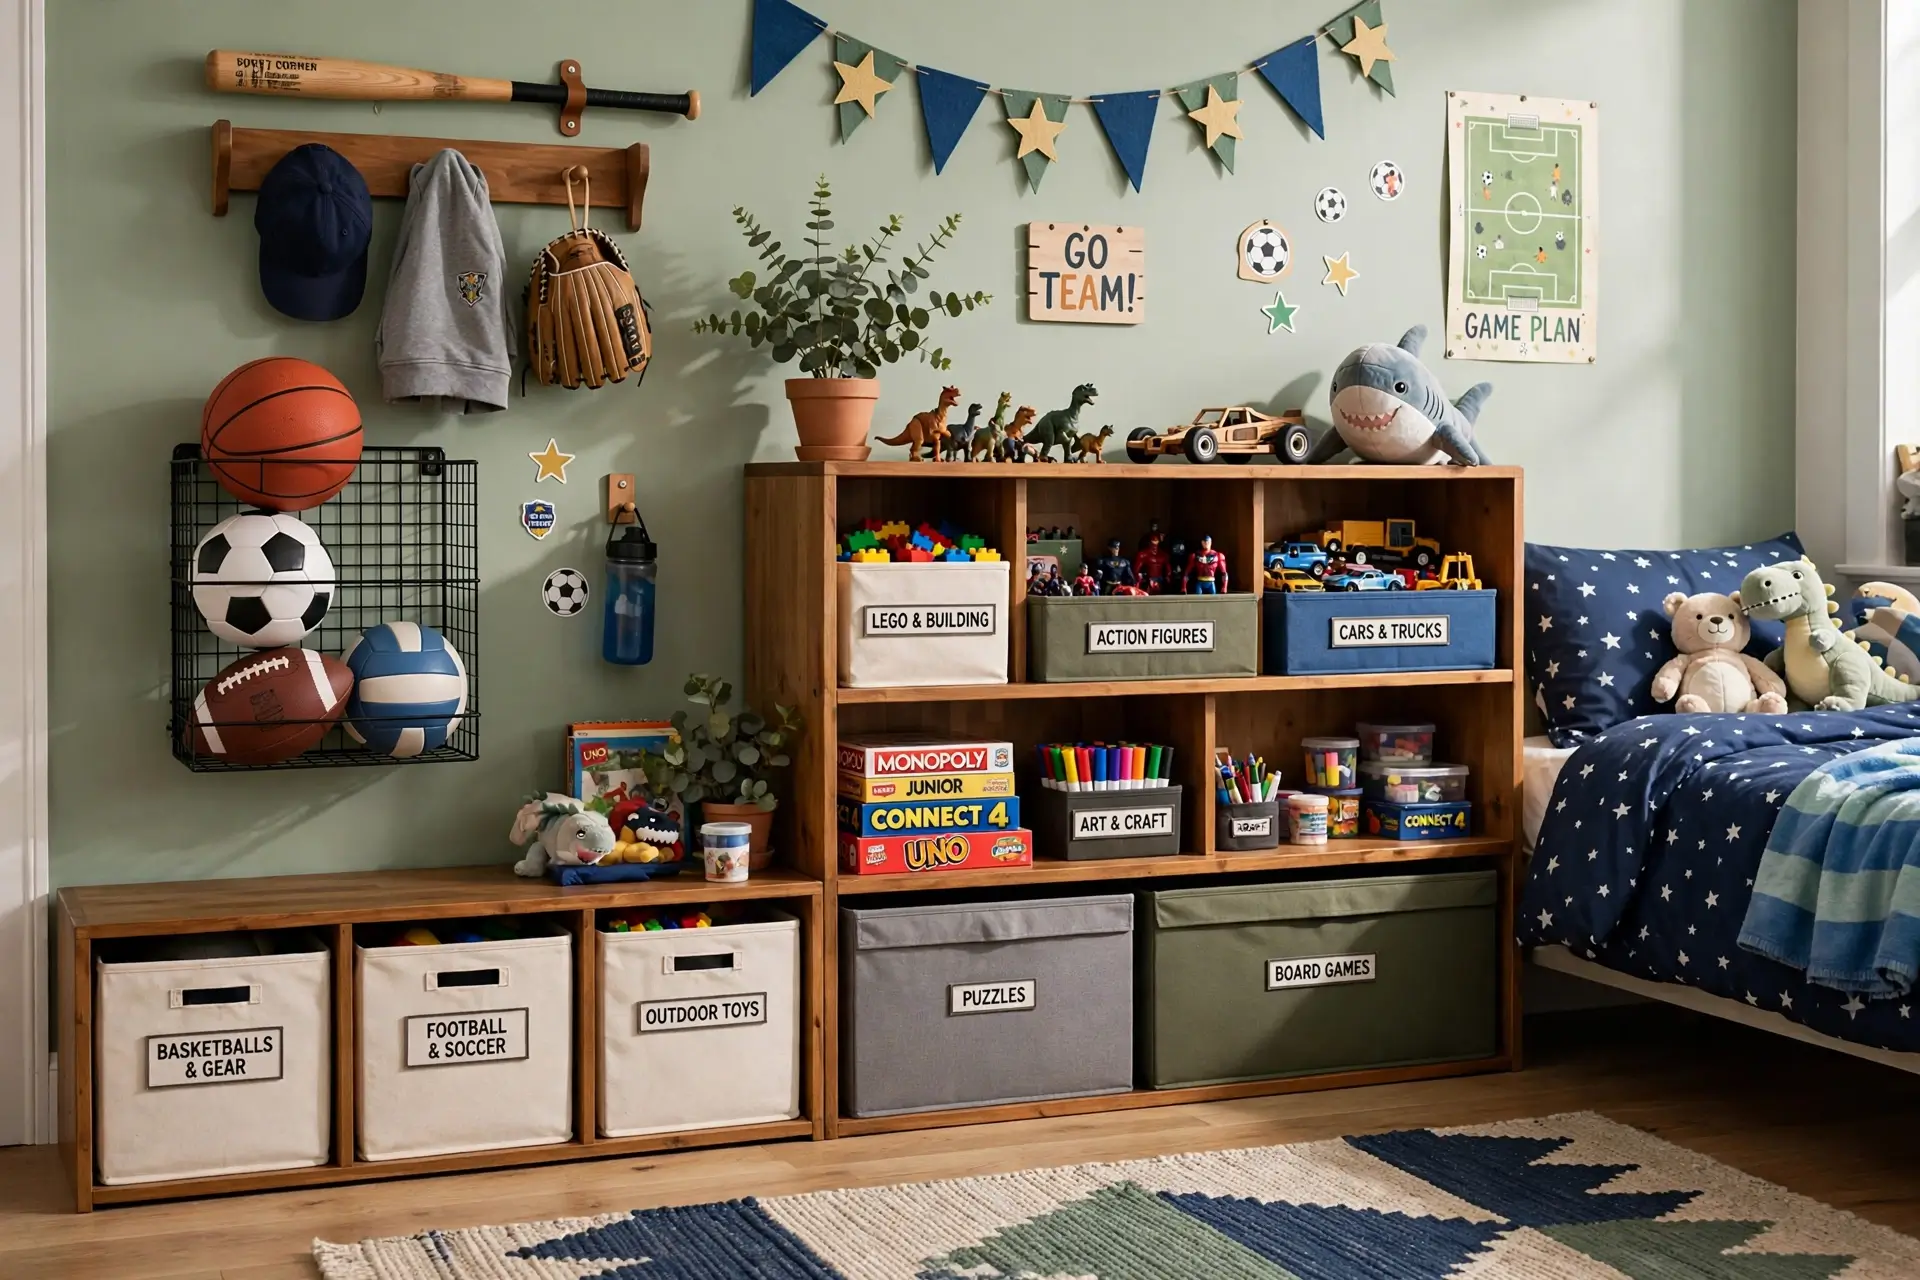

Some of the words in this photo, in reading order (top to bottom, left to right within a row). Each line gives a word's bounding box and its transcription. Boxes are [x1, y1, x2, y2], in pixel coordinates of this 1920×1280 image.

[1065, 232, 1108, 269] GO
[1039, 272, 1135, 313] TEAM!
[1465, 312, 1521, 341] GAME
[1531, 315, 1580, 343] PLAN
[872, 612, 908, 629] LEGO
[912, 612, 921, 628] &
[926, 611, 989, 628] BUILDING
[1339, 624, 1374, 640] CARS
[1378, 624, 1387, 639] &
[1391, 622, 1442, 639] TRUCKS
[1097, 629, 1147, 645] ACTION
[1151, 628, 1207, 645] FIGURES
[583, 747, 607, 761] UNO
[877, 749, 987, 772] MONOPOLY
[906, 778, 963, 796] JUNIOR
[870, 805, 983, 831] CONNECT
[988, 801, 1009, 829] 4
[1080, 816, 1107, 832] ART
[1110, 815, 1120, 830] &
[1124, 812, 1167, 830] CRAFT
[1404, 813, 1453, 828] CONNECT
[1454, 811, 1466, 829] 4
[904, 835, 970, 871] UNO
[1274, 962, 1321, 982] BOARD
[1325, 960, 1370, 978] GAMES
[962, 986, 1026, 1007] PUZZLES
[645, 1004, 719, 1025] OUTDOOR
[722, 1000, 760, 1019] TOYS
[426, 1017, 508, 1039] FOOTBALL
[157, 1035, 274, 1060] BASKETBALLS
[428, 1042, 440, 1059] &
[444, 1037, 506, 1057] SOCCER
[185, 1062, 198, 1078] &
[202, 1058, 246, 1077] GEAR
